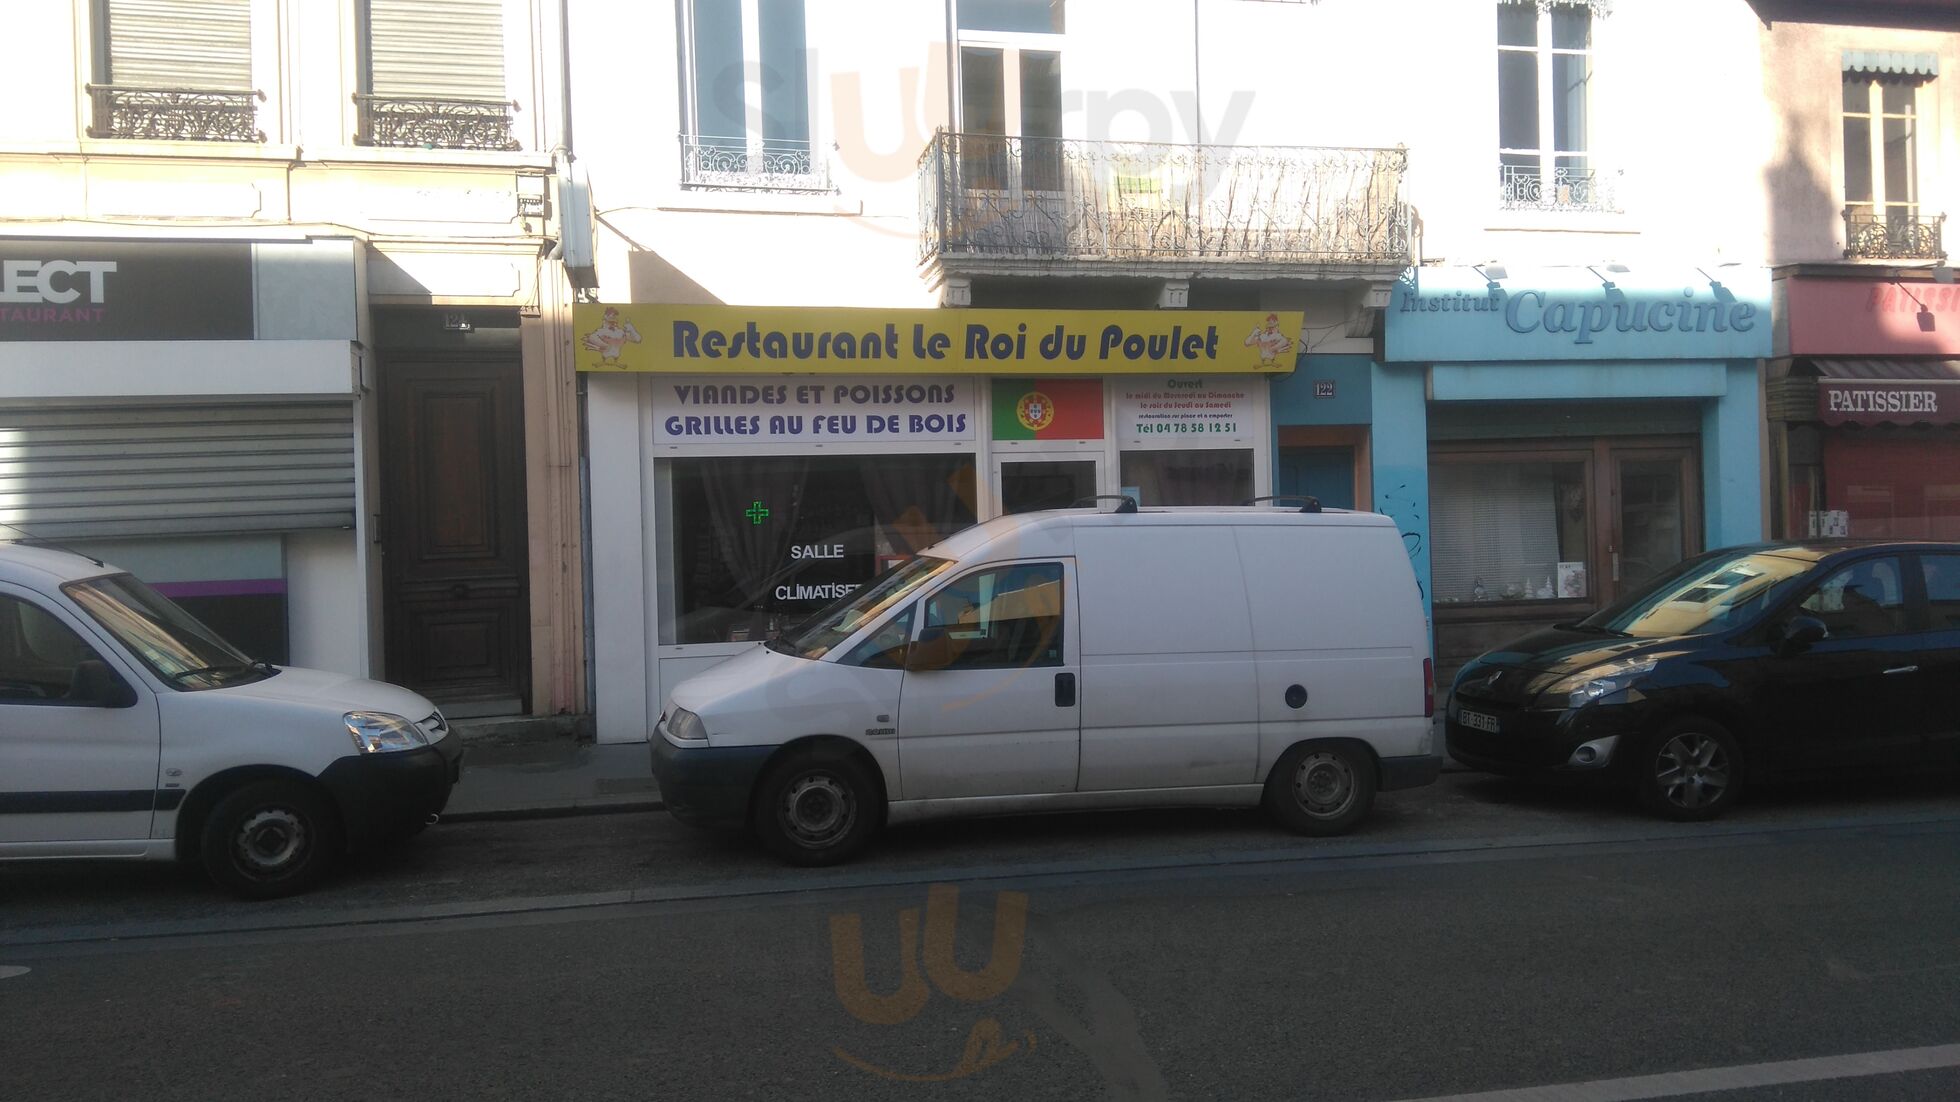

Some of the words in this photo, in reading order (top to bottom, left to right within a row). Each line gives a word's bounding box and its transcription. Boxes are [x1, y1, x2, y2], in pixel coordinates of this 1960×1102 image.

[1399, 291, 1500, 313] Institut
[1505, 287, 1756, 344] Capucine
[672, 320, 898, 359] Restaurant
[912, 323, 951, 359] Le
[965, 322, 1027, 360] Roi
[1039, 324, 1086, 360] du
[1099, 324, 1219, 360] Poulet
[673, 384, 787, 405] VIANDES
[796, 384, 825, 405] ET
[833, 384, 954, 404] POISSONS
[1167, 379, 1203, 389] Ouvert
[1316, 383, 1333, 396] 122
[1828, 390, 1938, 413] PATISSIER
[664, 415, 760, 436] GRILLES
[769, 415, 803, 435] AU
[812, 415, 856, 434] FEU
[866, 415, 900, 434] DE
[909, 413, 966, 433] BOIS
[1136, 423, 1153, 433] Tél
[1156, 423, 1170, 433] 04
[1174, 423, 1187, 433] 78
[1191, 423, 1204, 433] 58
[1209, 423, 1221, 433] 12
[1225, 423, 1237, 433] 51
[791, 544, 844, 559] SALLE
